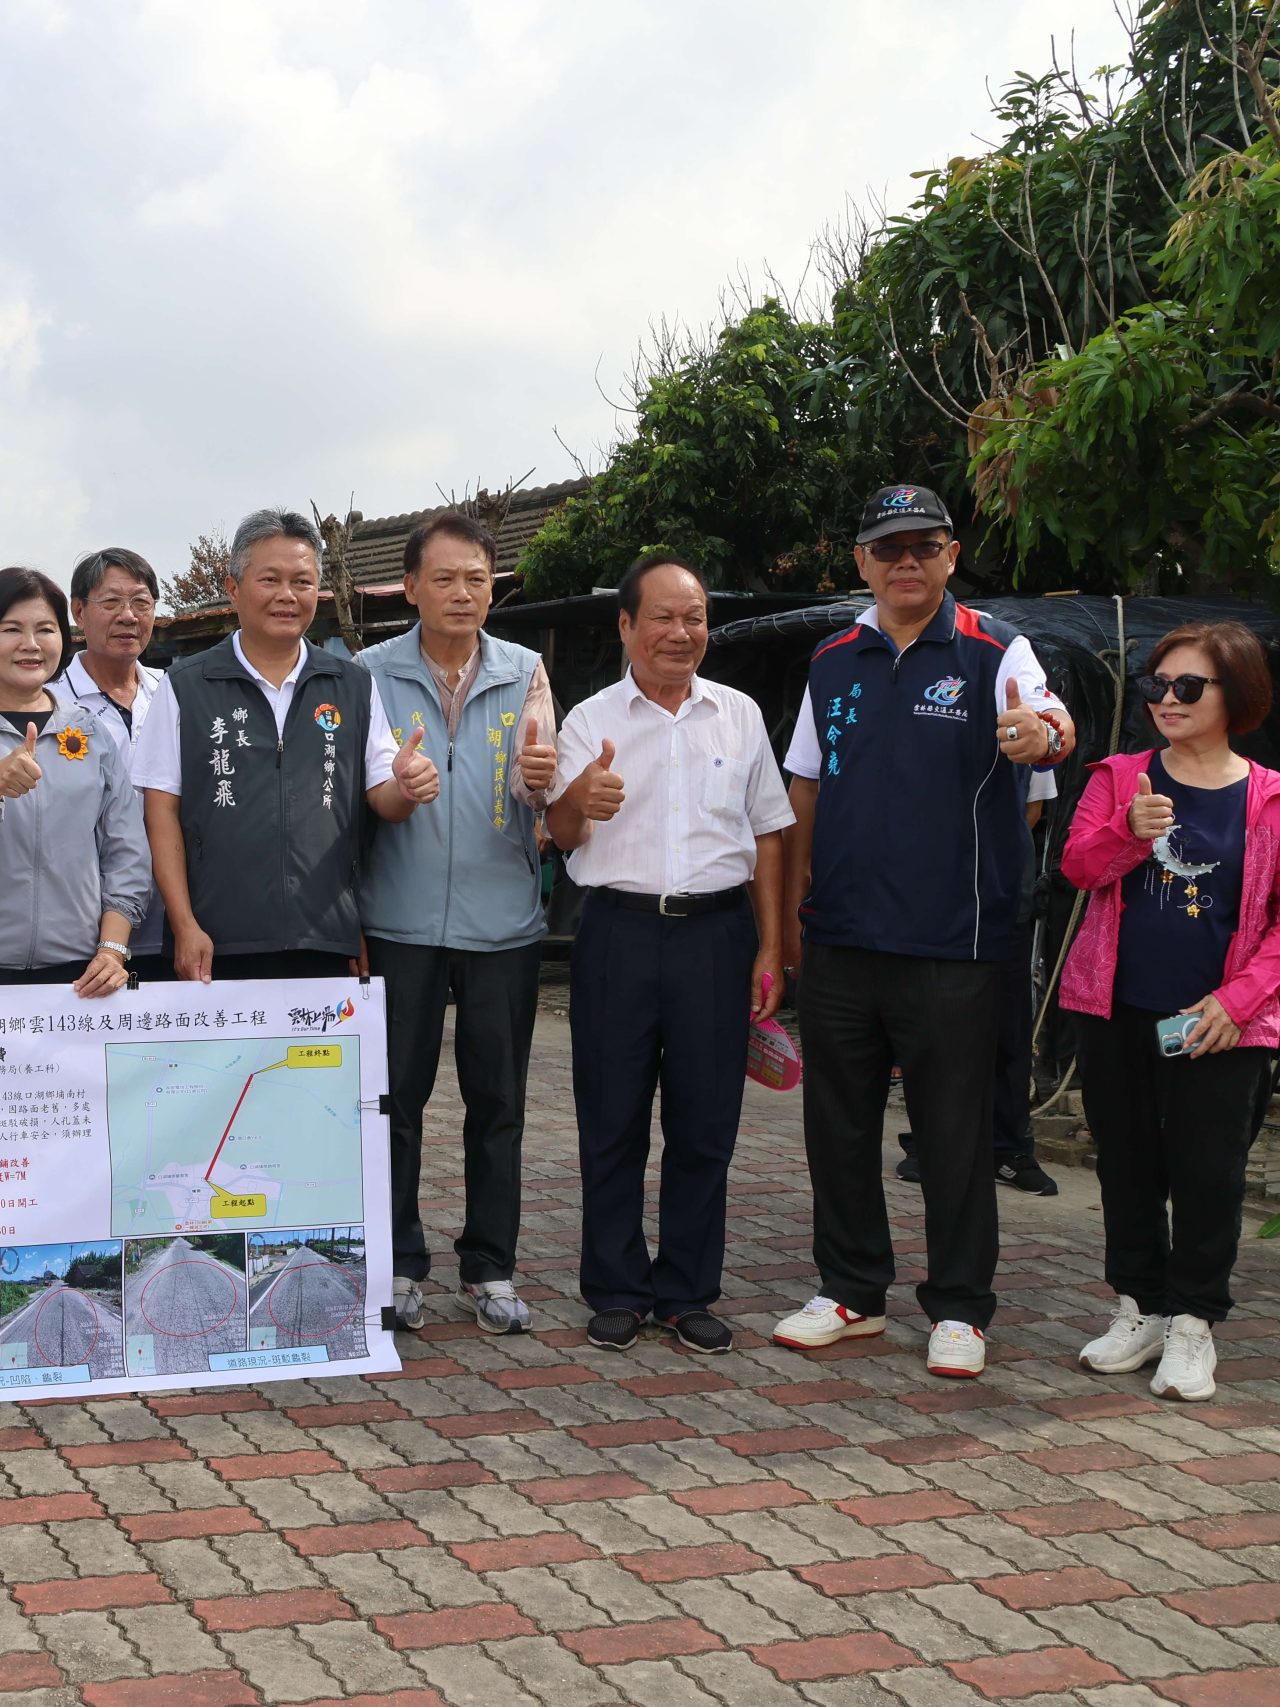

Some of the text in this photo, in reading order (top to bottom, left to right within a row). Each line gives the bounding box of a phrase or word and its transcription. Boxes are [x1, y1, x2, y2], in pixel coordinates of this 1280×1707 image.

[231, 707, 252, 748] 鄉長
[826, 697, 842, 776] 汪令堯
[845, 682, 862, 725] 局長
[208, 716, 236, 808] 李龍飛
[322, 732, 336, 810] 口湖鄉公所
